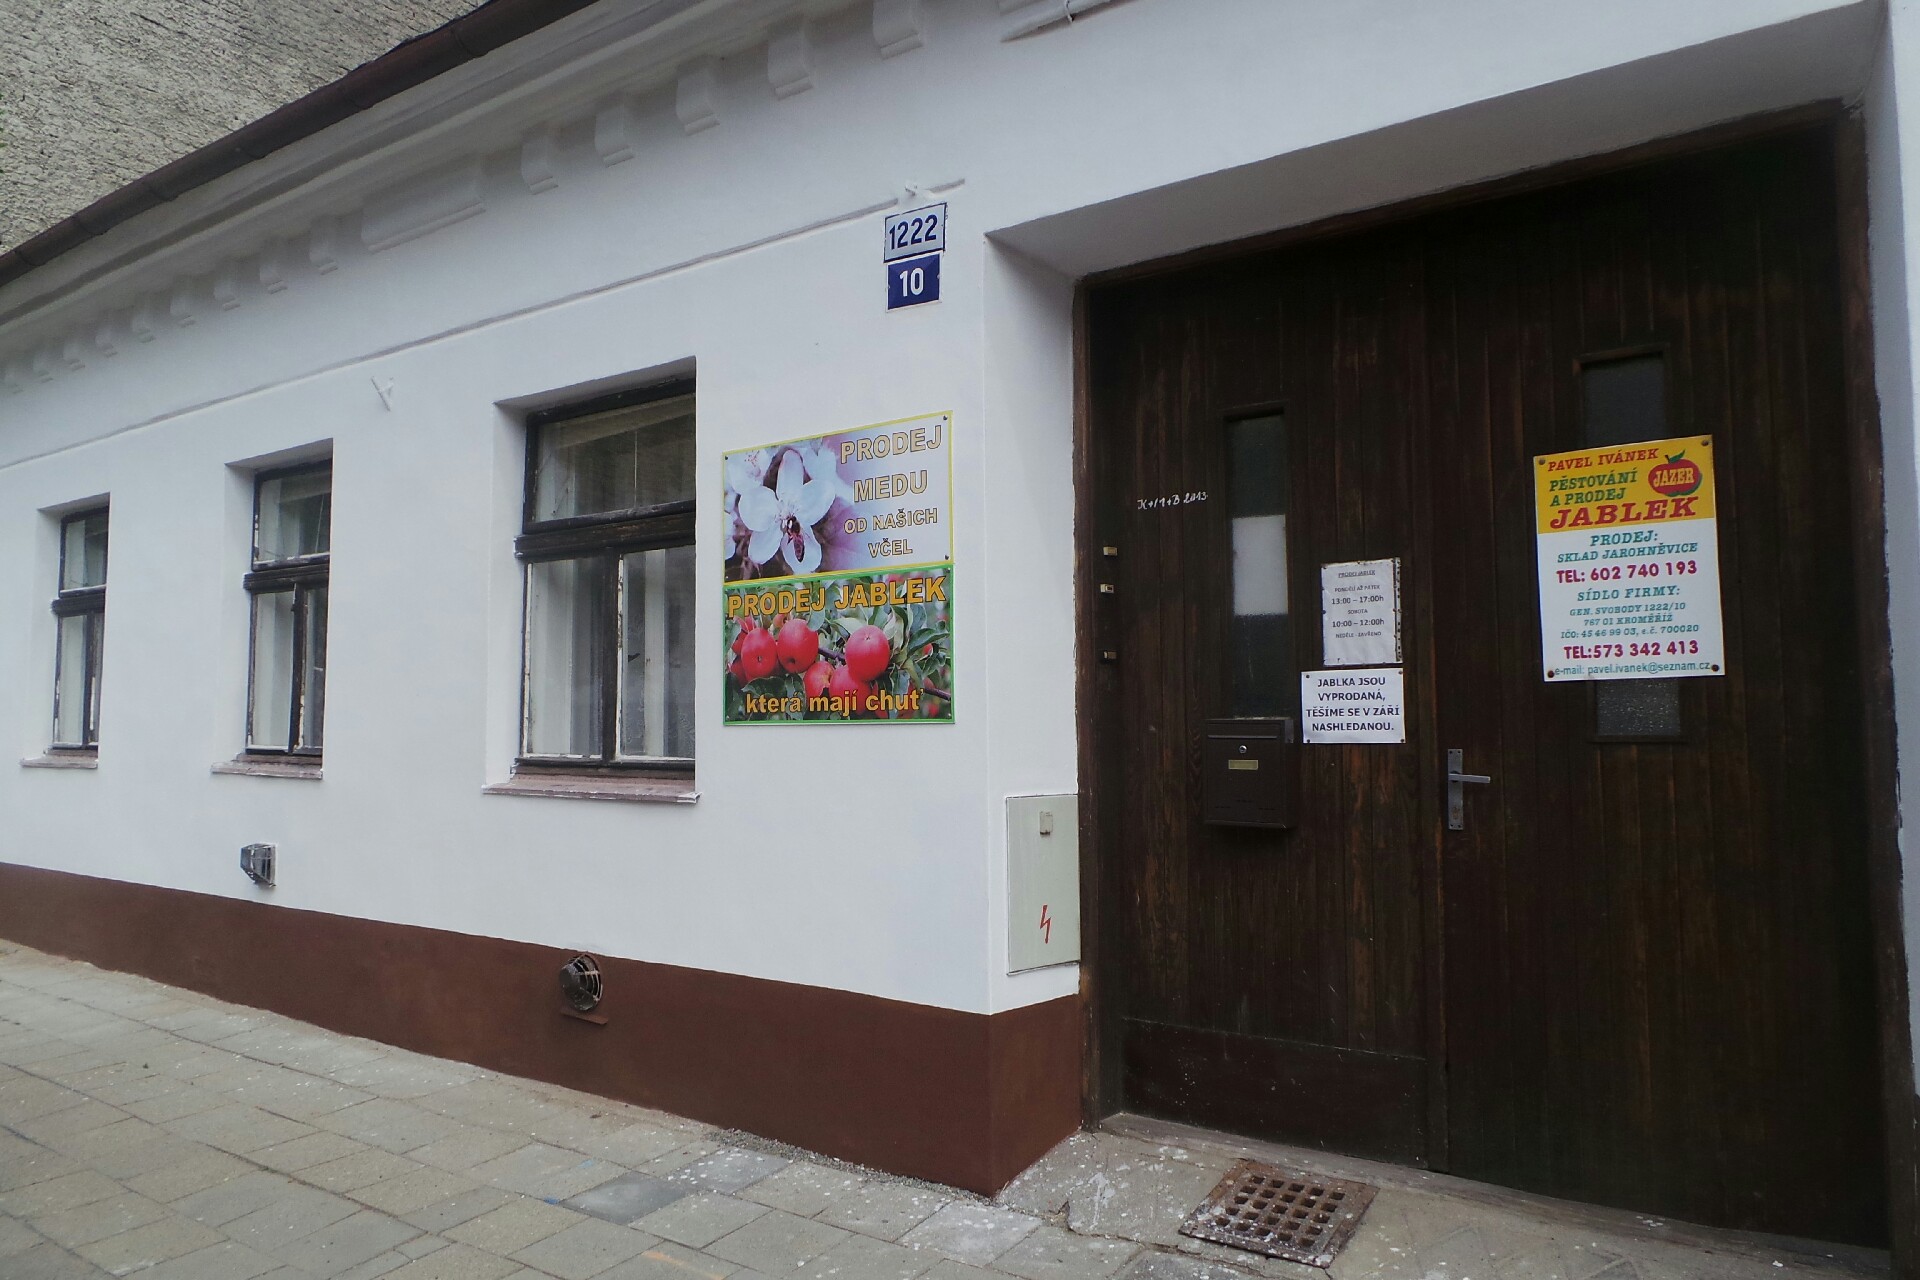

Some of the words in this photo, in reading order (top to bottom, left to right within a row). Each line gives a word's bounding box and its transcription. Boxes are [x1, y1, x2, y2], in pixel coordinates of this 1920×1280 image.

[889, 214, 938, 250] 1222
[900, 268, 924, 297] 10
[841, 425, 942, 464] PRODEJ
[1548, 456, 1592, 472] PAVEL
[1598, 448, 1659, 466] IVÁNEK
[854, 470, 928, 502] MEDU
[1549, 467, 1638, 492] PĚSTOVÁNÍ
[1653, 467, 1694, 488] JAZER
[1550, 494, 1560, 507] A
[1564, 487, 1626, 506] PRODEJ
[844, 518, 867, 534] OD
[873, 508, 938, 530] NAŠICH
[1550, 496, 1699, 529] JABLEK
[868, 538, 913, 558] VČEL
[1590, 530, 1658, 547] PRODEJ:
[1558, 550, 1598, 563] SKLAD
[1602, 542, 1698, 559] JAROHNĚVICE
[1556, 570, 1586, 584] TEL:
[1590, 566, 1621, 582] 602
[1627, 563, 1659, 578] 740
[1666, 560, 1698, 576] 193
[727, 586, 826, 618] PRODEJ
[835, 576, 946, 610] JABLEK
[1360, 595, 1384, 603] 17:00h
[1578, 588, 1619, 602] SÍDLO
[1624, 585, 1680, 598] FIRMY:
[1570, 608, 1594, 616] GEN.
[1596, 604, 1642, 615] SVOBODY
[1644, 602, 1686, 612] 1222/10
[1584, 618, 1600, 626] 767
[1616, 614, 1673, 624] KROMĚŘÍŽ
[1560, 628, 1579, 639] IČO:
[1581, 630, 1592, 638] 45
[1609, 628, 1622, 637] 99
[1660, 624, 1700, 634] 700020
[1630, 642, 1661, 656] 342
[1667, 640, 1699, 654] 413
[1555, 666, 1584, 676] e-mail:
[1588, 661, 1710, 677] pavel.ivanek@seznam.cz
[1318, 678, 1355, 687] JABLKA
[1358, 677, 1386, 686] JSOU
[746, 693, 802, 714] která
[809, 690, 858, 717] mají
[865, 688, 924, 712] chuť
[1318, 689, 1386, 701] VYPRODANÁ,
[1306, 706, 1344, 717] TĚŠÍME
[1348, 708, 1360, 716] SE
[1363, 708, 1370, 716] V
[1373, 704, 1400, 716] ZÁŘÍ
[1312, 722, 1394, 732] NASHLEDANOU.
